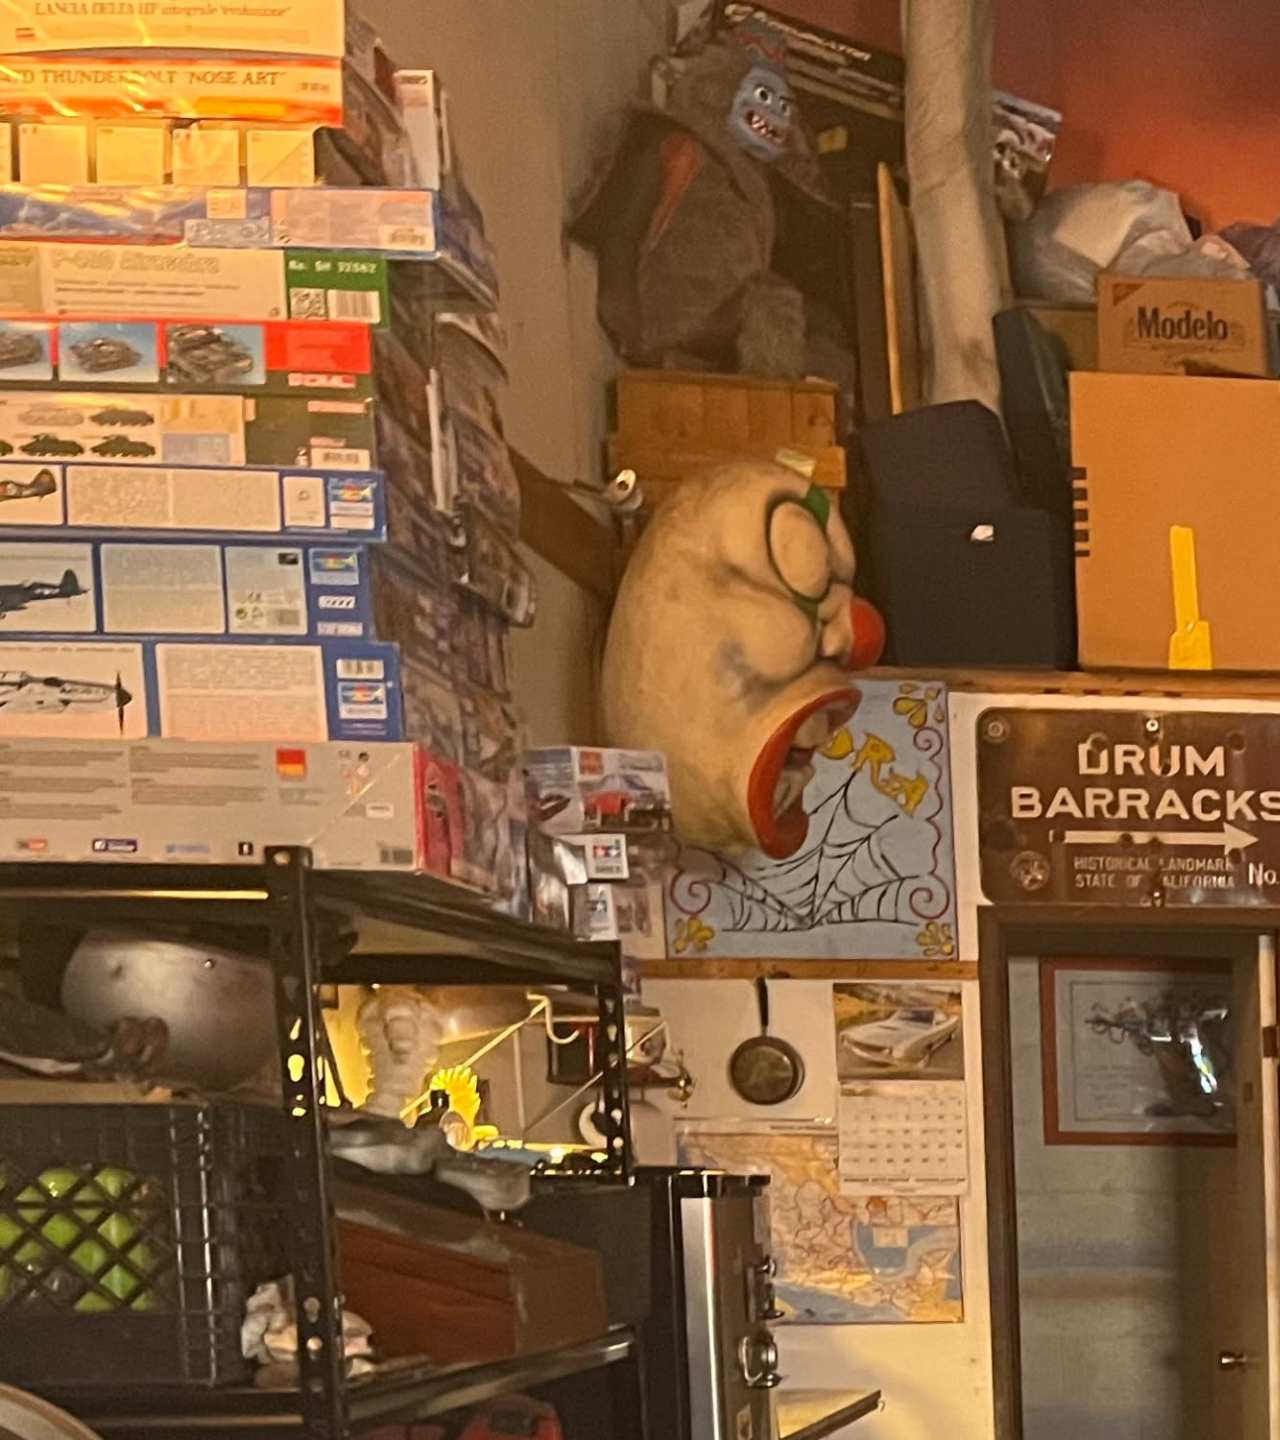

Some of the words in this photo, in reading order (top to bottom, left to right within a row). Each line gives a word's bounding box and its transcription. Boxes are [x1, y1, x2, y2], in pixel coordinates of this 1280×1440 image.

[1137, 306, 1228, 340] Modelo
[1077, 743, 1226, 778] DRUM
[1073, 856, 1151, 871] HISTORICAL
[1074, 874, 1116, 889] STATE
[1125, 875, 1142, 889] OF
[1158, 874, 1235, 890] ALIFORNIA
